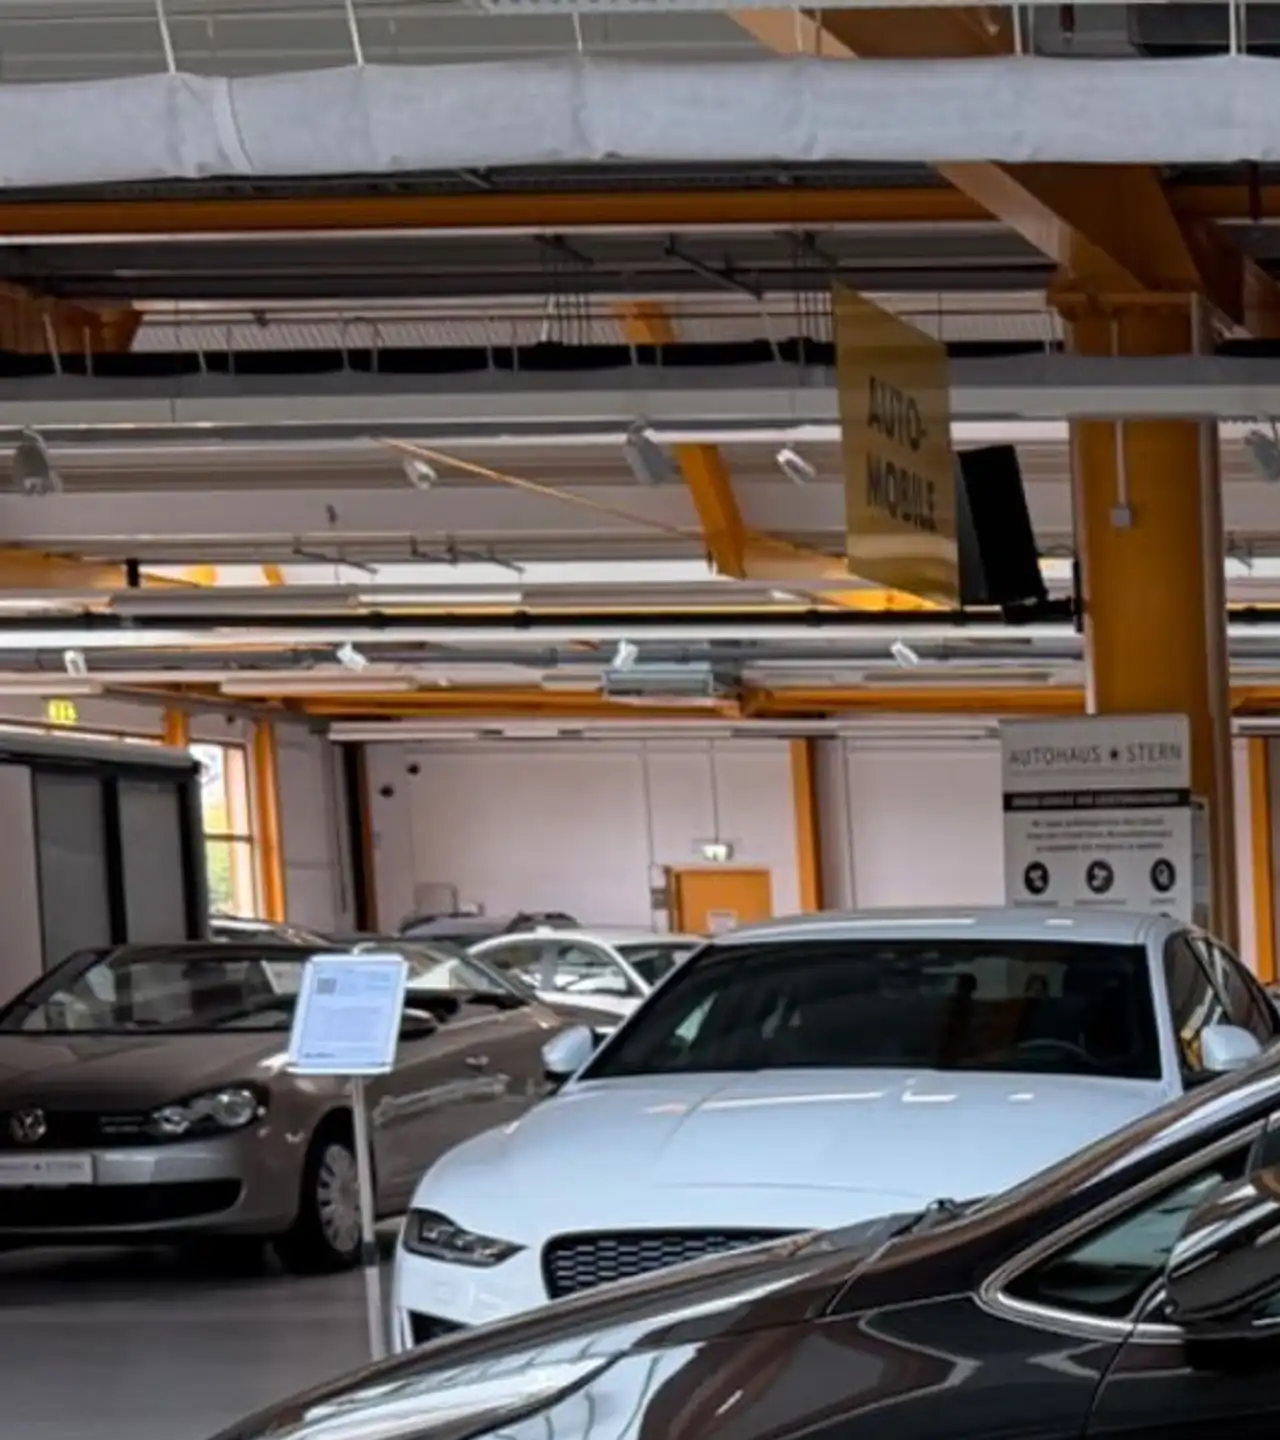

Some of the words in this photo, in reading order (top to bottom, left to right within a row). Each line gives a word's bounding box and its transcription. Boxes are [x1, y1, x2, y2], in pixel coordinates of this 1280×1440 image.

[867, 376, 927, 450] AUTO-
[1009, 745, 1101, 767] AUTOHAUS
[1126, 742, 1182, 762] STERN
